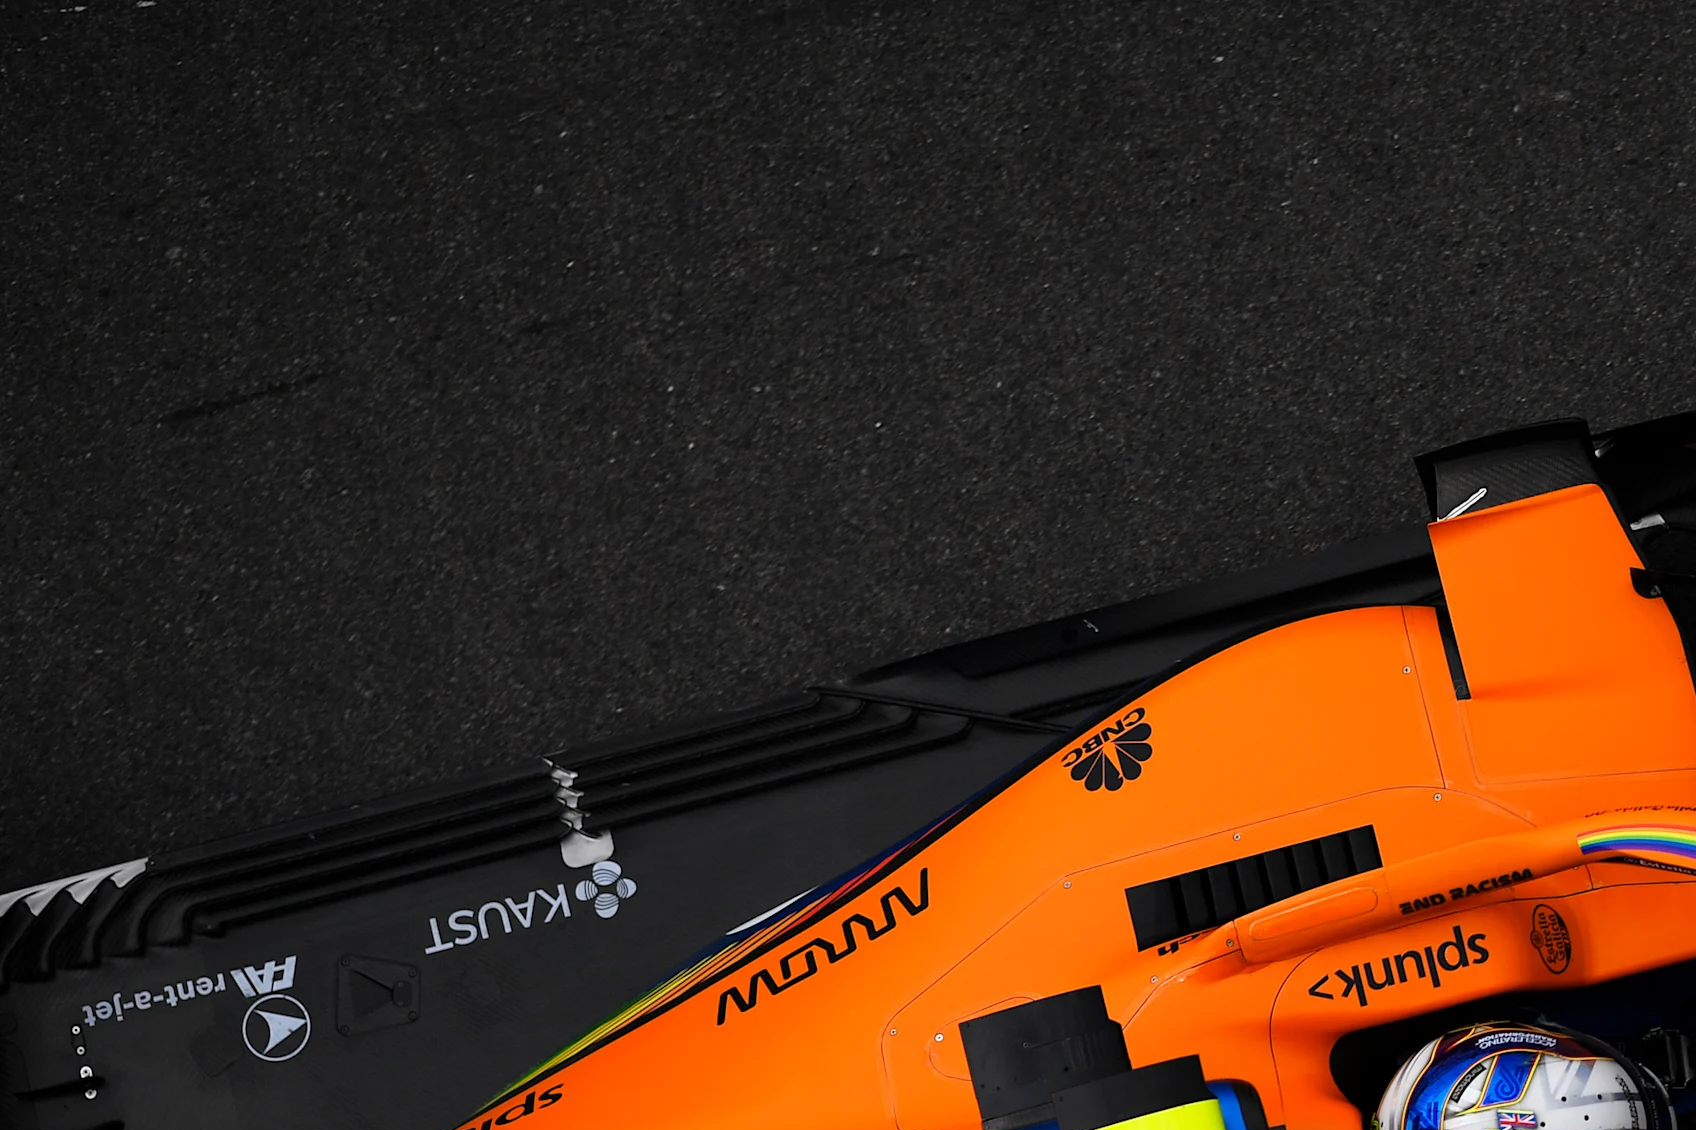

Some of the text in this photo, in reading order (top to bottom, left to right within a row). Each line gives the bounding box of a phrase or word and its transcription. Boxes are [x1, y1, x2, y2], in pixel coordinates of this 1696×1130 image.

[1061, 707, 1145, 767] CNBC
[425, 883, 572, 954] KAUST
[1399, 868, 1533, 915] END RACISM
[83, 955, 297, 1028] FAI rent-a-jet
[1479, 1036, 1556, 1050] ACCELERATING
